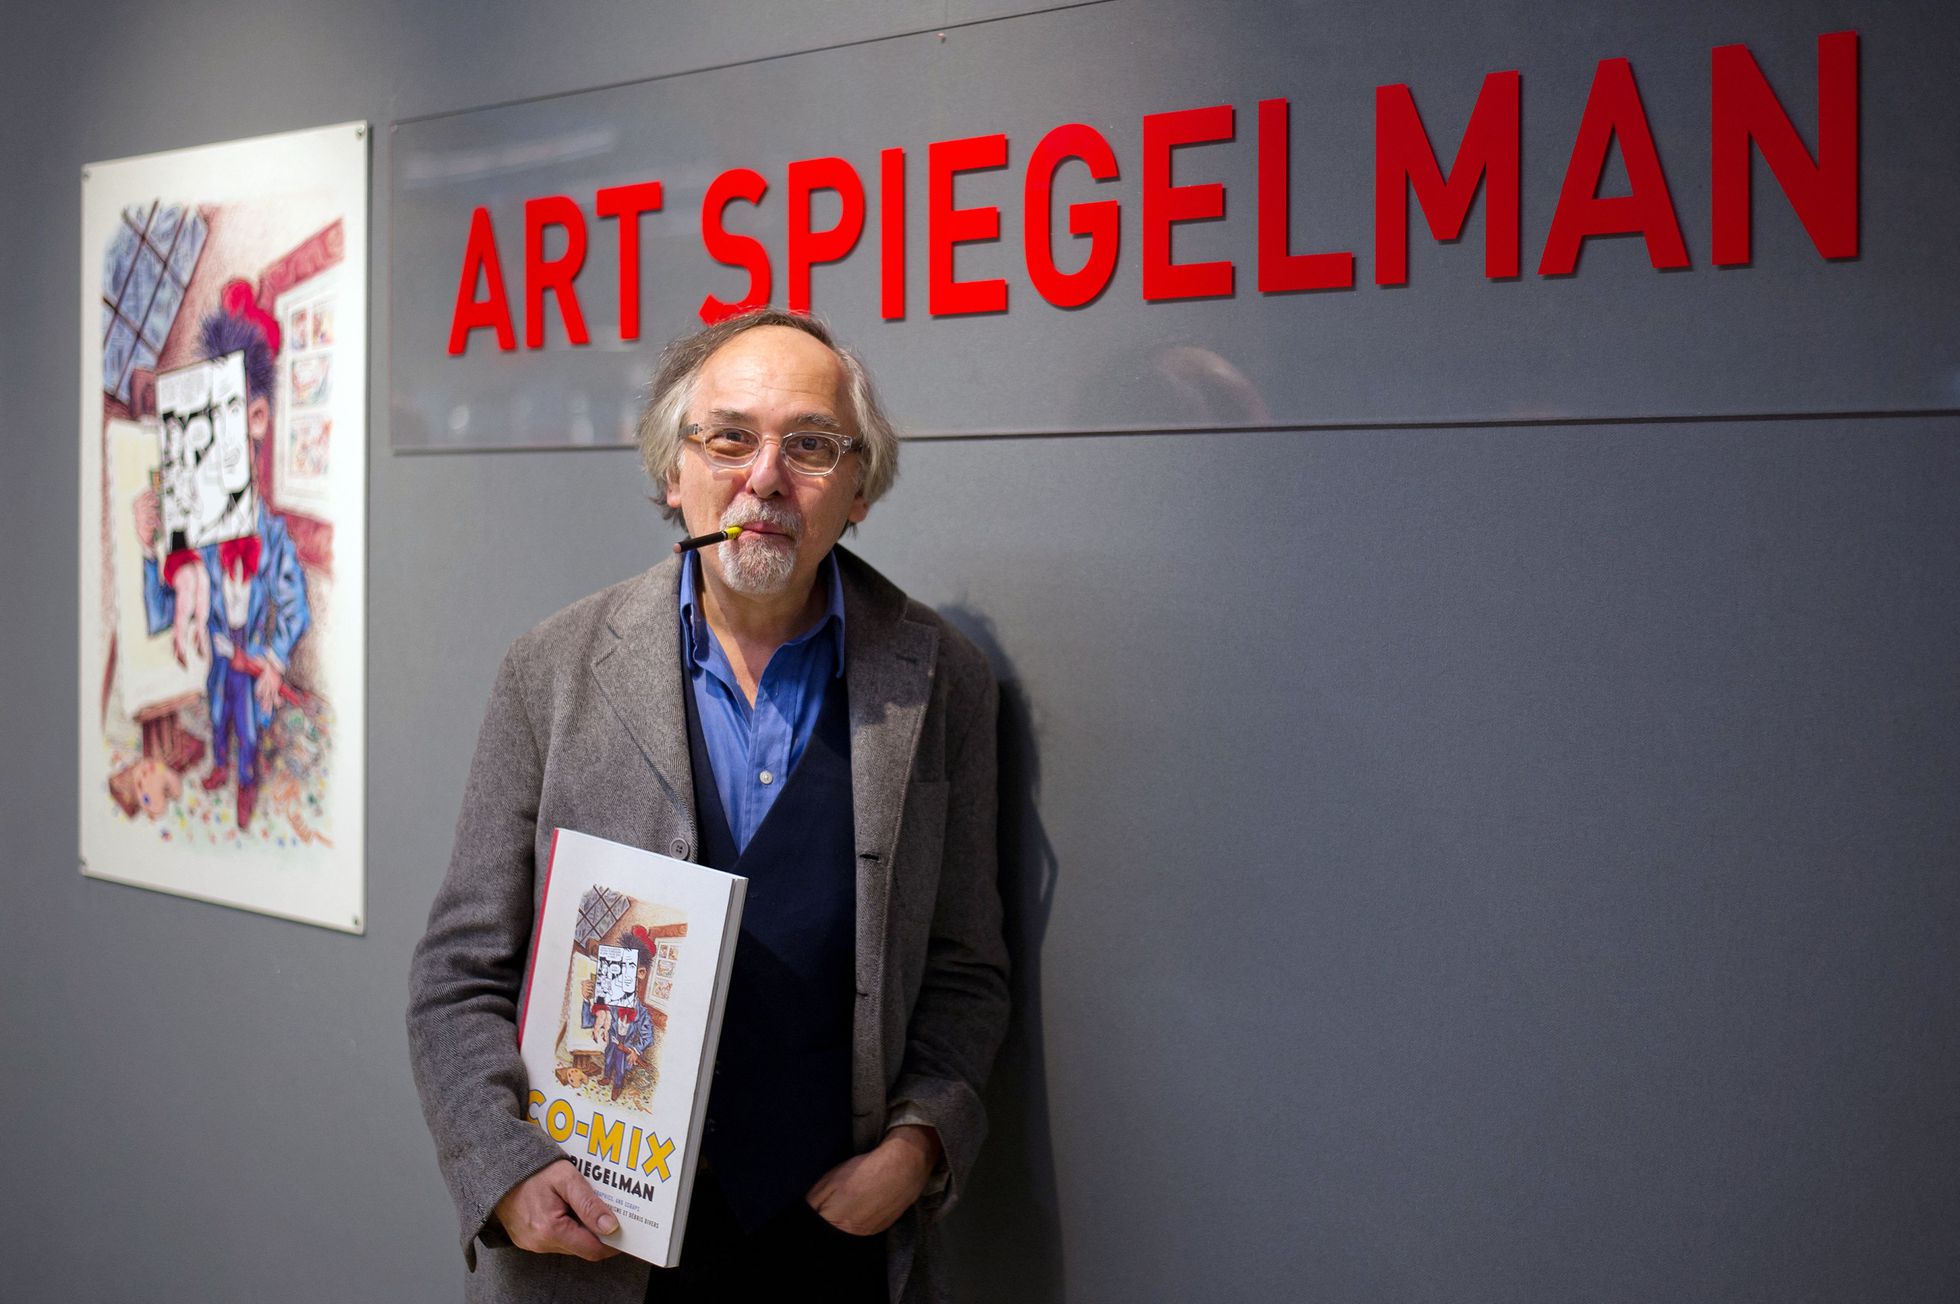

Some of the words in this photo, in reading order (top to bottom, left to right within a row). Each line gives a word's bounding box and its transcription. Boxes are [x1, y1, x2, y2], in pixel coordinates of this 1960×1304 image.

[449, 180, 664, 355] ART
[698, 29, 1860, 326] SPIEGELMAN
[528, 1089, 676, 1183] CO-MIX
[569, 1155, 654, 1201] PIEGELMAN
